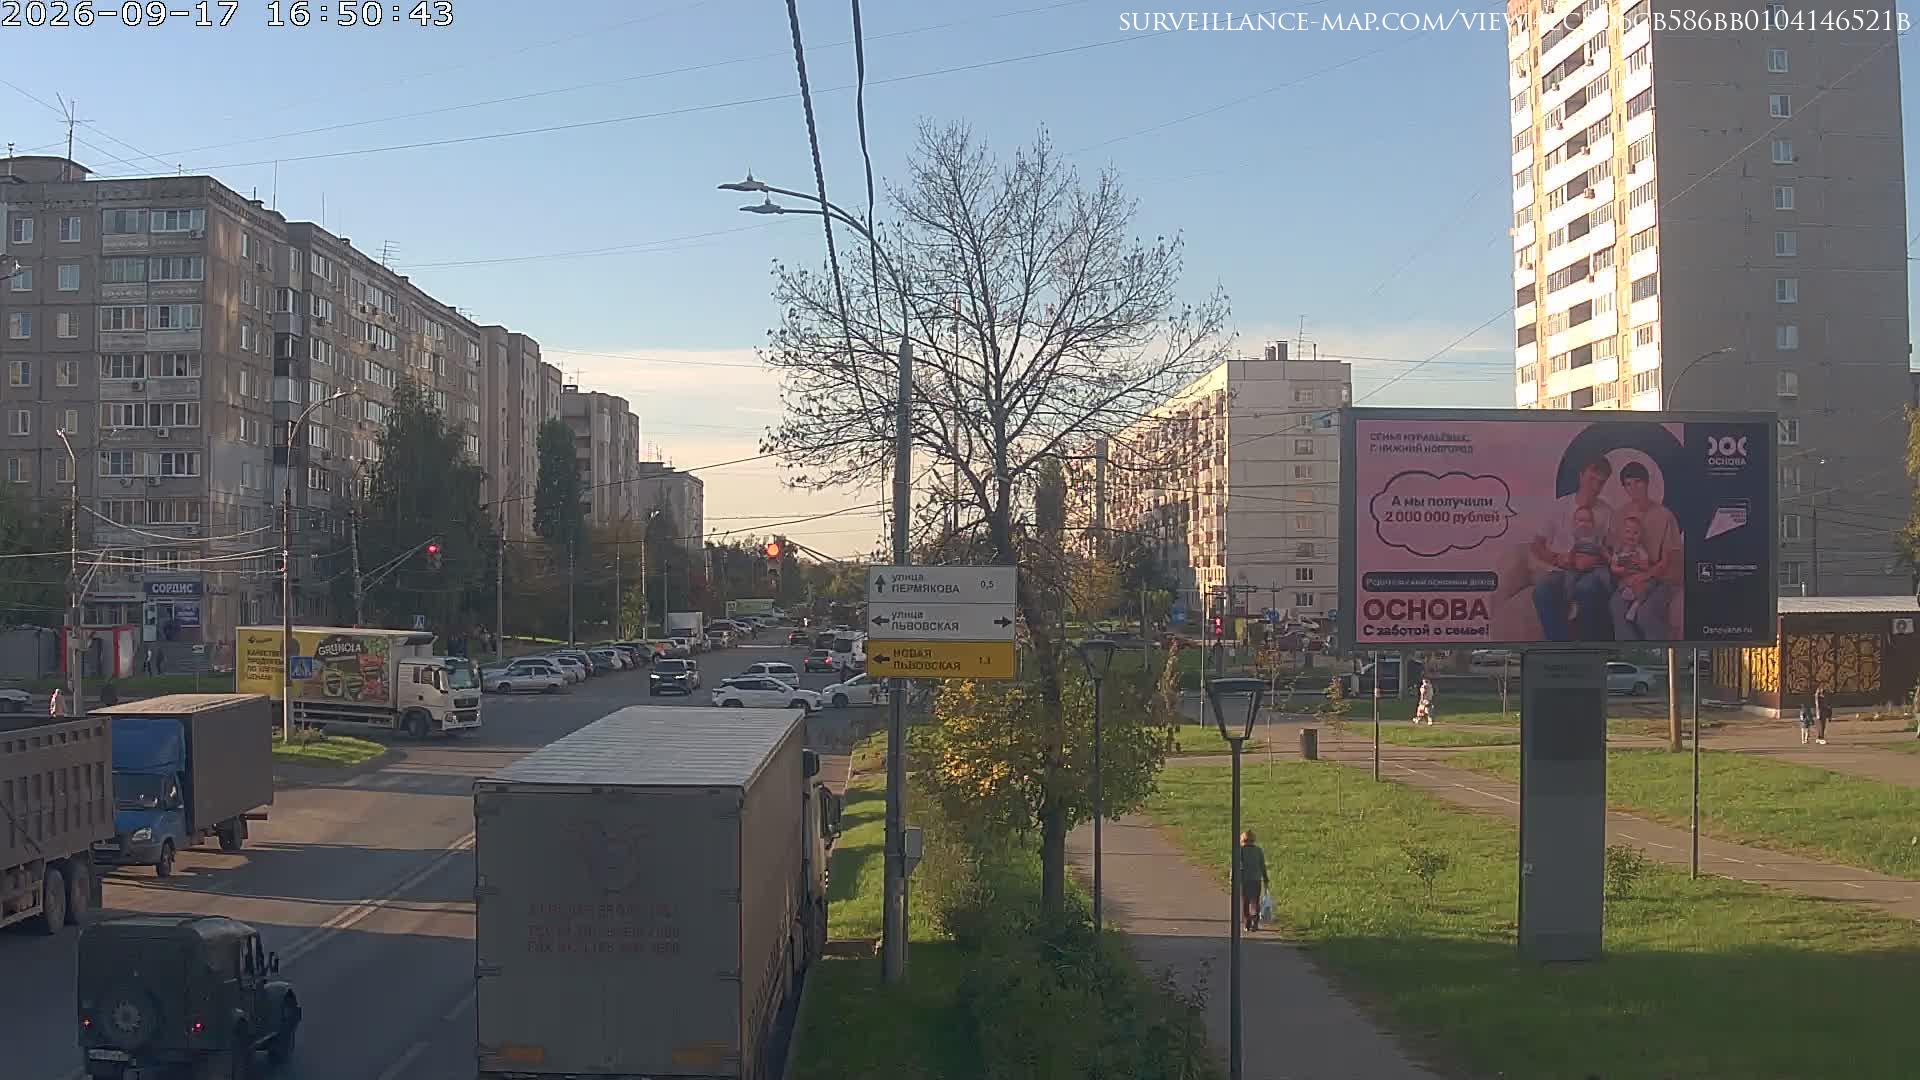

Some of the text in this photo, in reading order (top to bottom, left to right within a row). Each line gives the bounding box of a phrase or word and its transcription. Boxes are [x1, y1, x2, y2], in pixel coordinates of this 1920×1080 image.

[1391, 496, 1494, 510] А мы получили
[1453, 510, 1501, 525] рублей
[892, 584, 961, 594] ПЕРМЯКОВА
[1363, 598, 1490, 621] ОСНОВА
[892, 611, 924, 620] улица
[892, 622, 960, 632] ЛЬВОВСКАЯ
[1363, 624, 1490, 637] С заботой о семье!
[894, 648, 932, 658] НОВАЯ
[893, 661, 961, 671] ЛЬВОВСКАЯ
